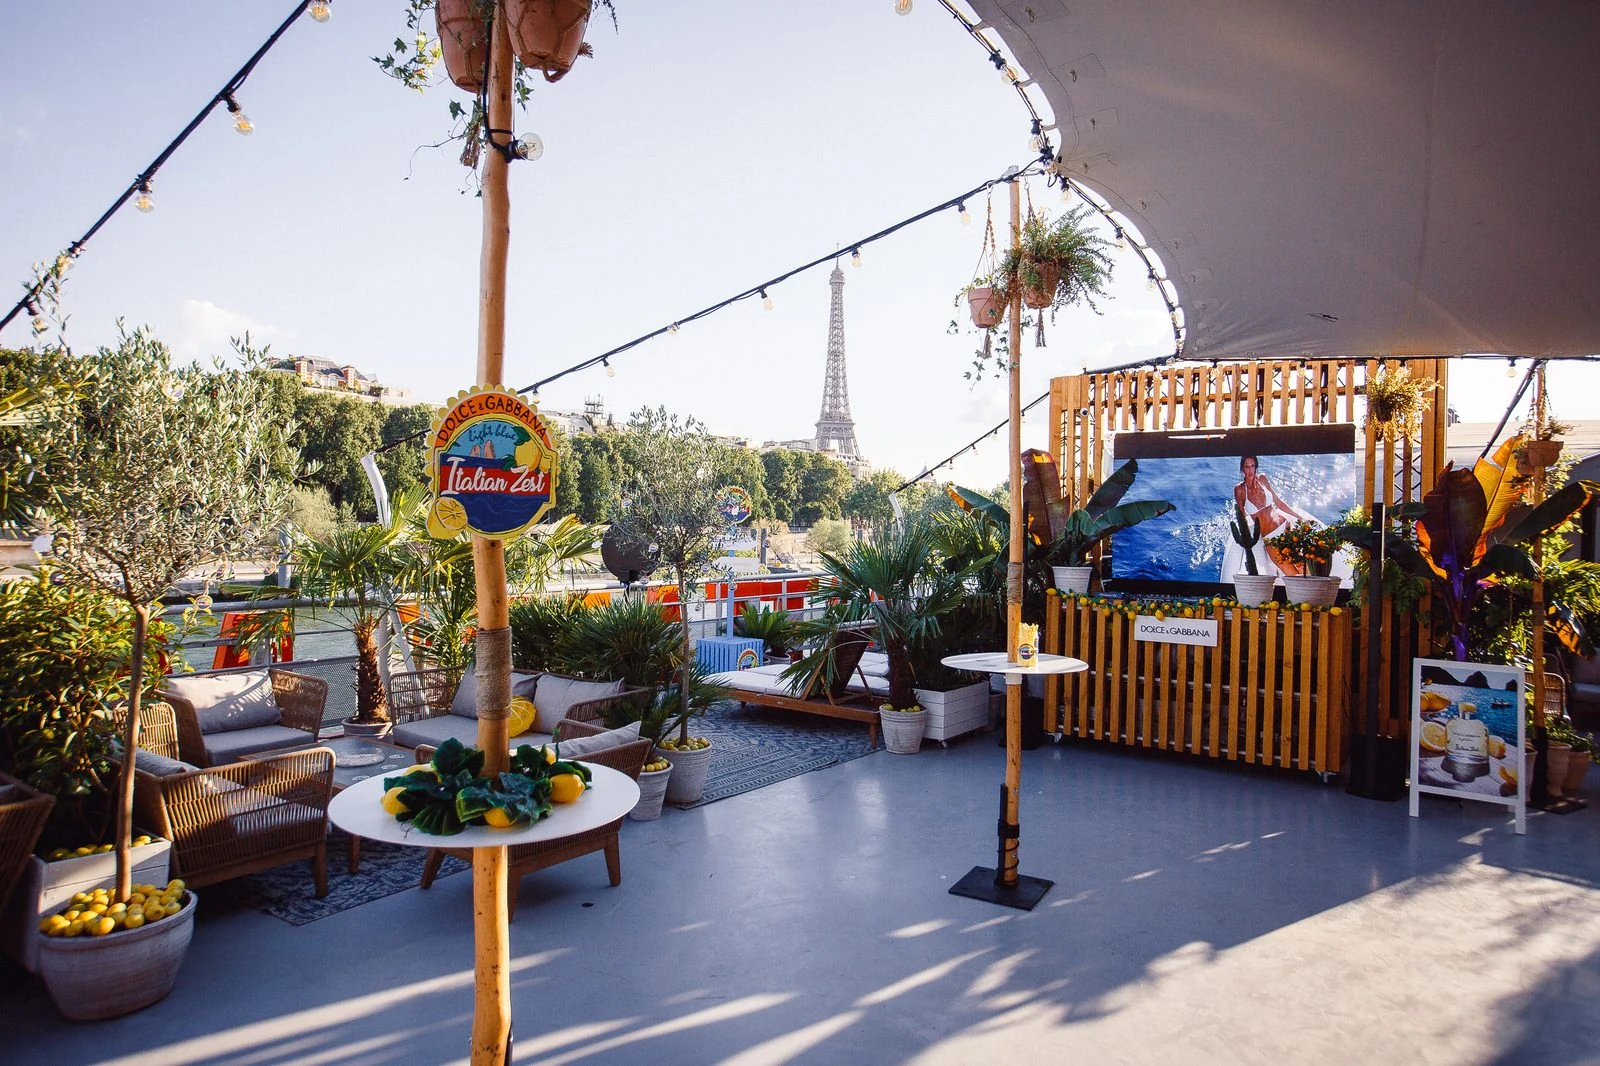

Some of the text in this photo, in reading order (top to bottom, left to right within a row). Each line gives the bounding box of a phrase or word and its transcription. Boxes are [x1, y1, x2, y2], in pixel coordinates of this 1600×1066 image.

[437, 400, 477, 442] DOLCE
[485, 396, 547, 439] GABBANA
[441, 456, 545, 496] Italian Zest
[1140, 625, 1165, 634] DOLCE
[1169, 627, 1210, 637] GABBANA
